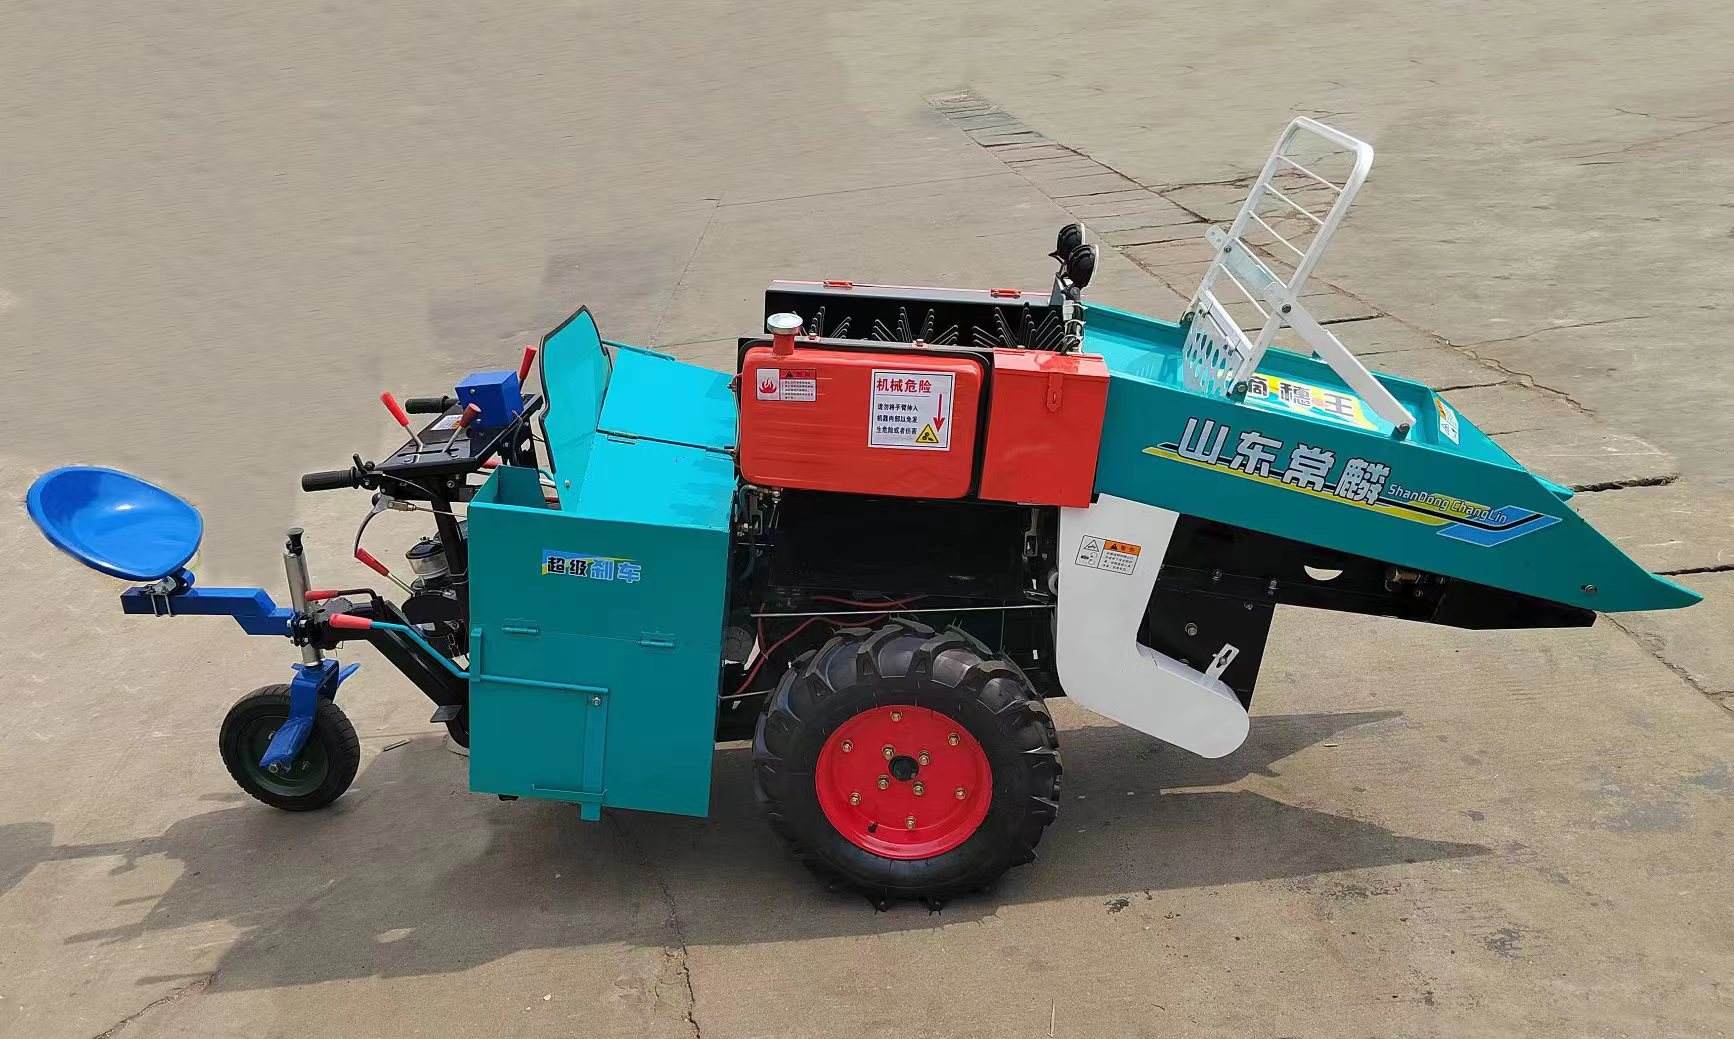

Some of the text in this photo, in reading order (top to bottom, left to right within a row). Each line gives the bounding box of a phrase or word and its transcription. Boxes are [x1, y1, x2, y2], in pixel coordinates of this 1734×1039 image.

[877, 378, 932, 394] 机械危险
[1178, 416, 1392, 506] 山东常麟
[1387, 484, 1508, 523] ShanDong ChangLin
[547, 555, 642, 584] 超级刹车
